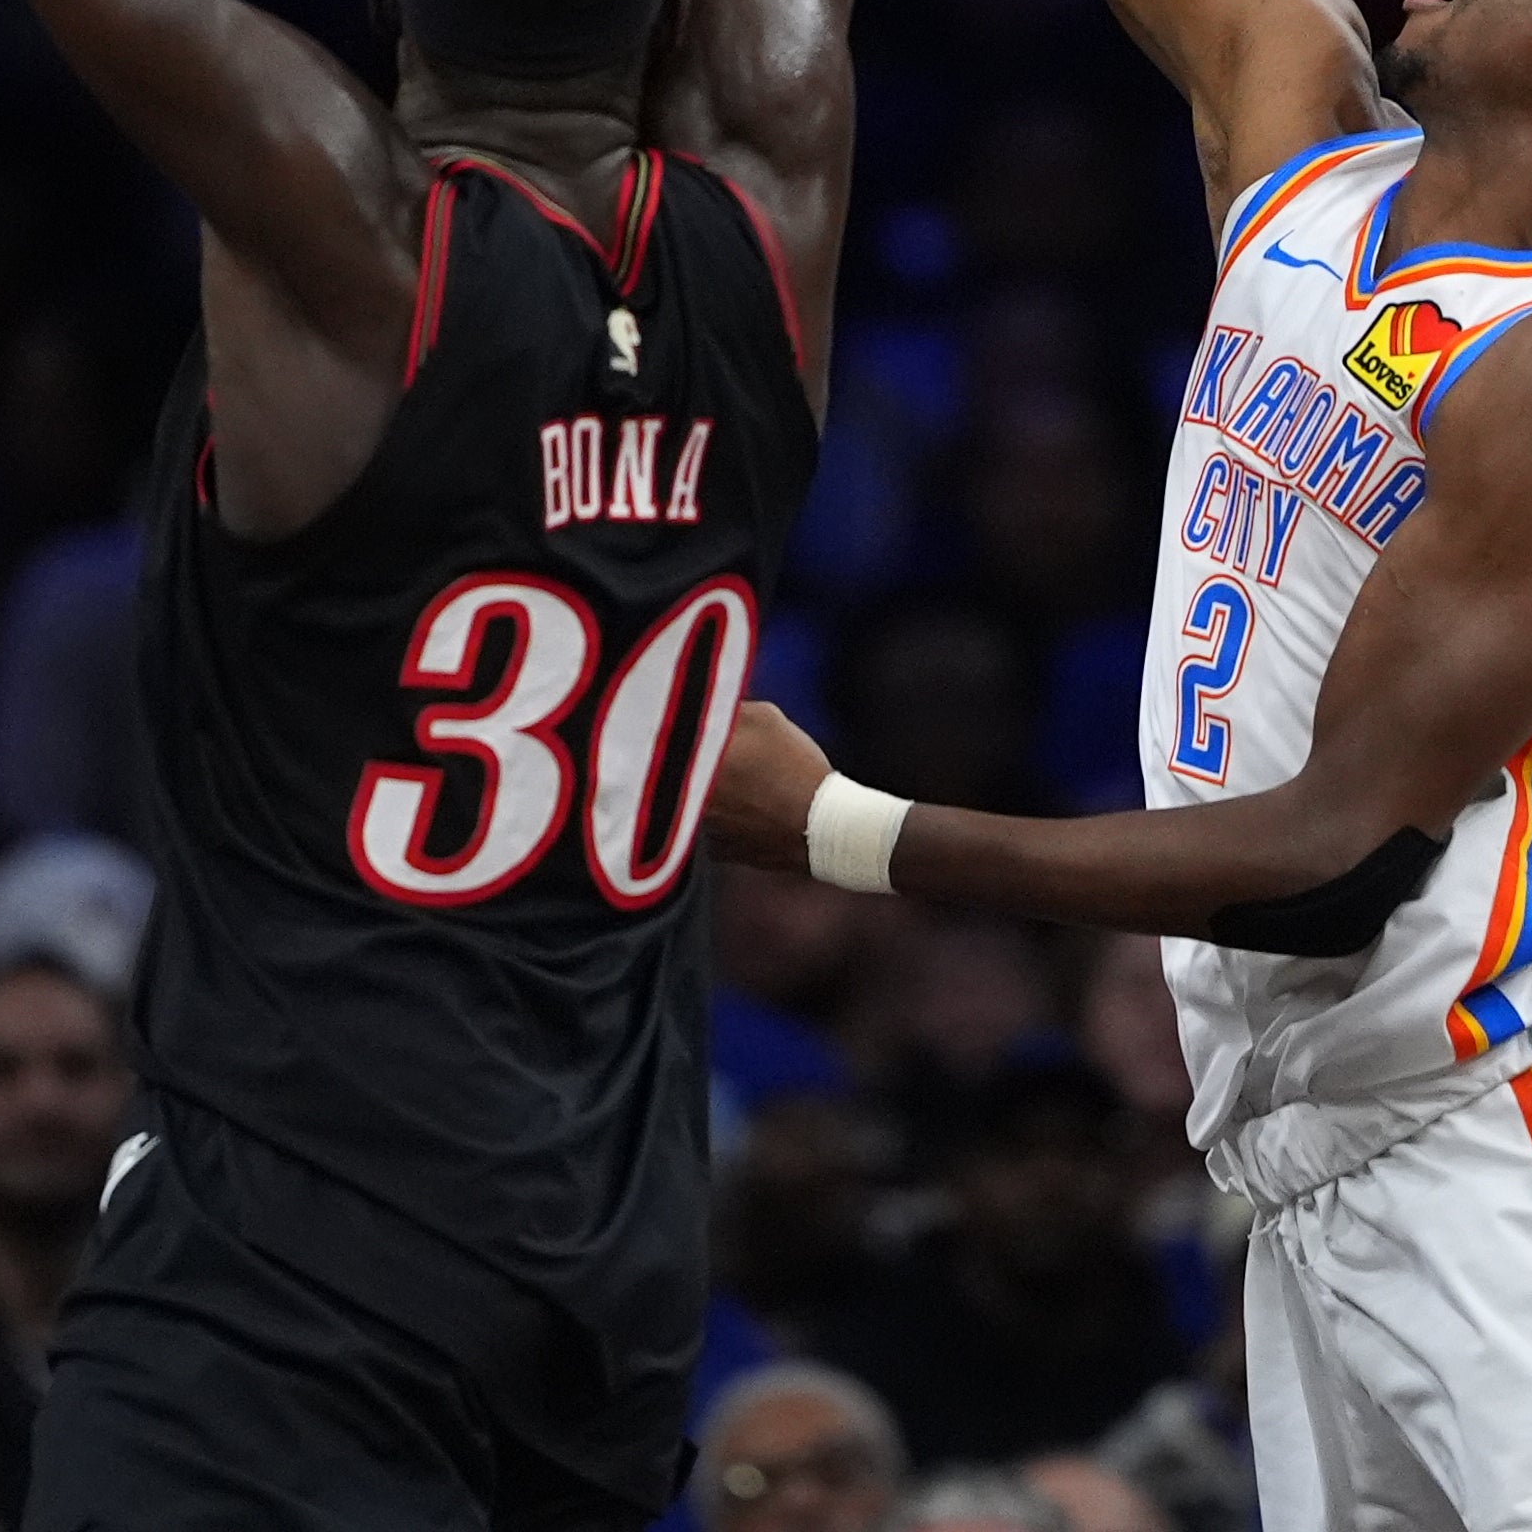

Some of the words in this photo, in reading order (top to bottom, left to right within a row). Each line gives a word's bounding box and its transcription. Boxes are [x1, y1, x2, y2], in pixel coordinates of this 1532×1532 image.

[540, 414, 715, 532] BONA
[1181, 451, 1305, 588] CITY
[346, 571, 758, 911] 30
[1167, 574, 1255, 787] 2
